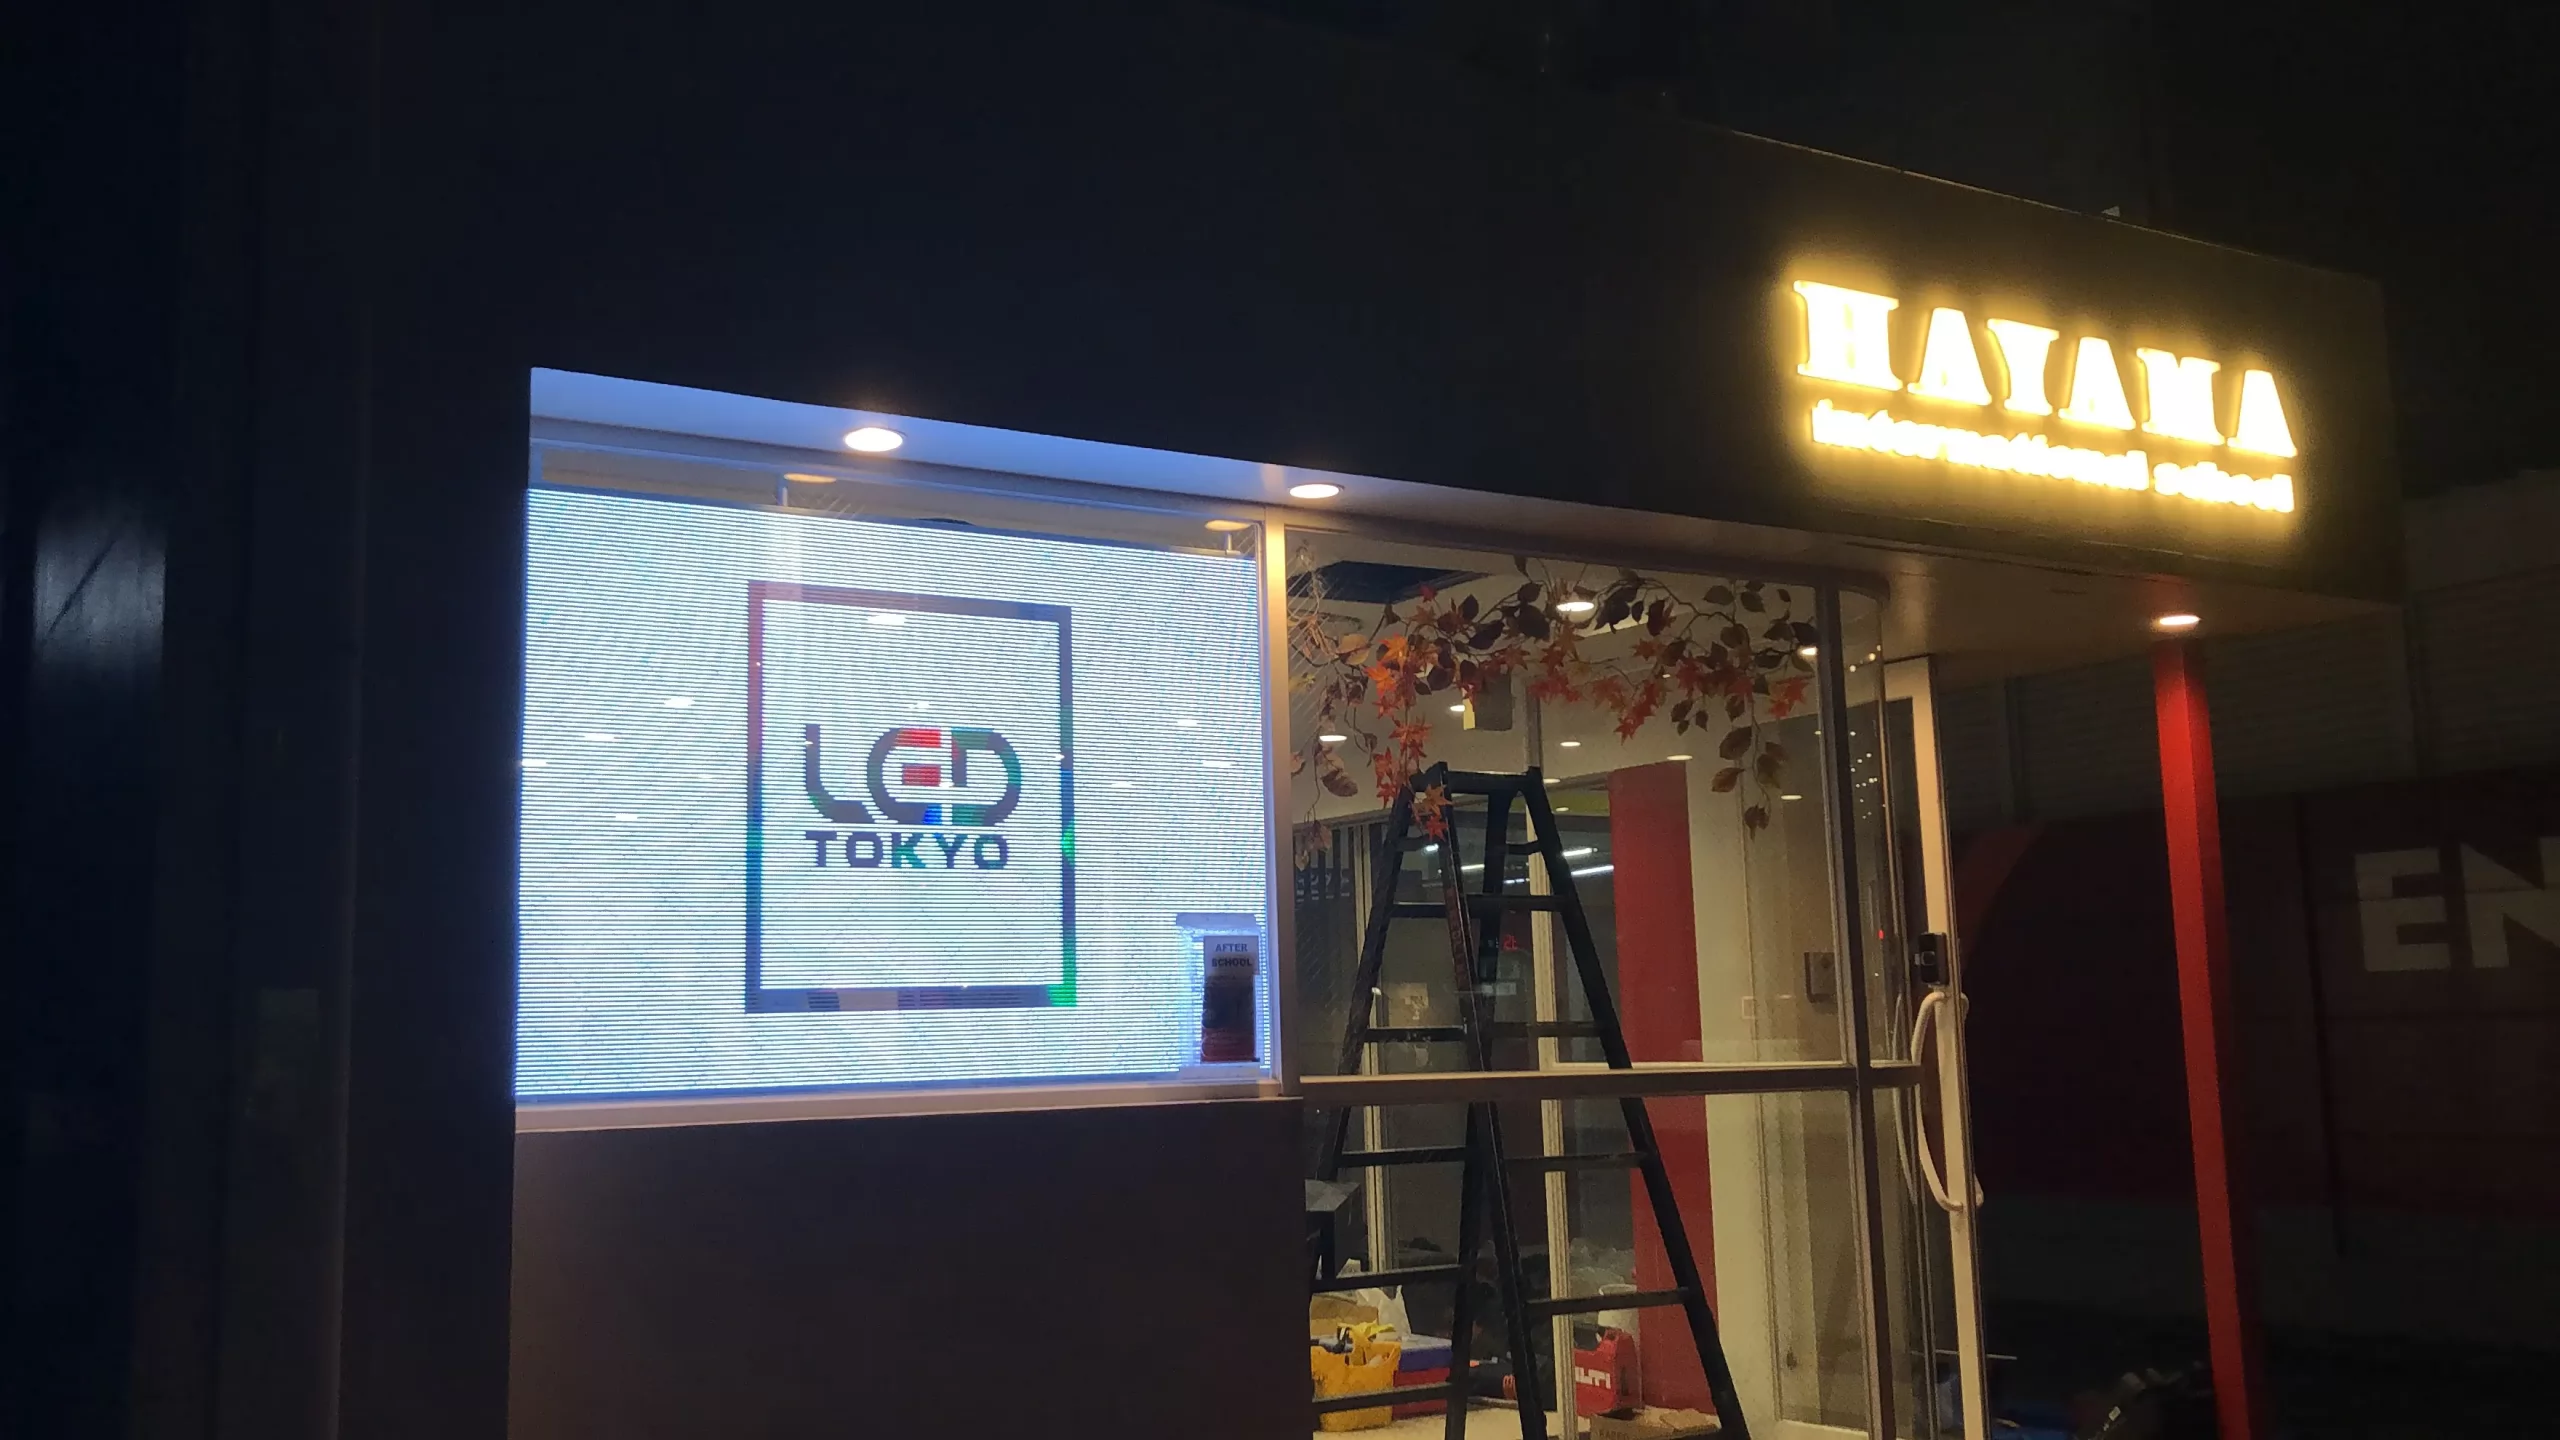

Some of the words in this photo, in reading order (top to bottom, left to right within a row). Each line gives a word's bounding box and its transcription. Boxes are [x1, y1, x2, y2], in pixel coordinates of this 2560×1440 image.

[1793, 279, 2298, 458] HAYAMA
[805, 723, 1022, 826] LED
[805, 830, 1009, 869] TOKYO
[1211, 957, 1252, 967] SCHOOL
[1215, 943, 1248, 952] AFTER
